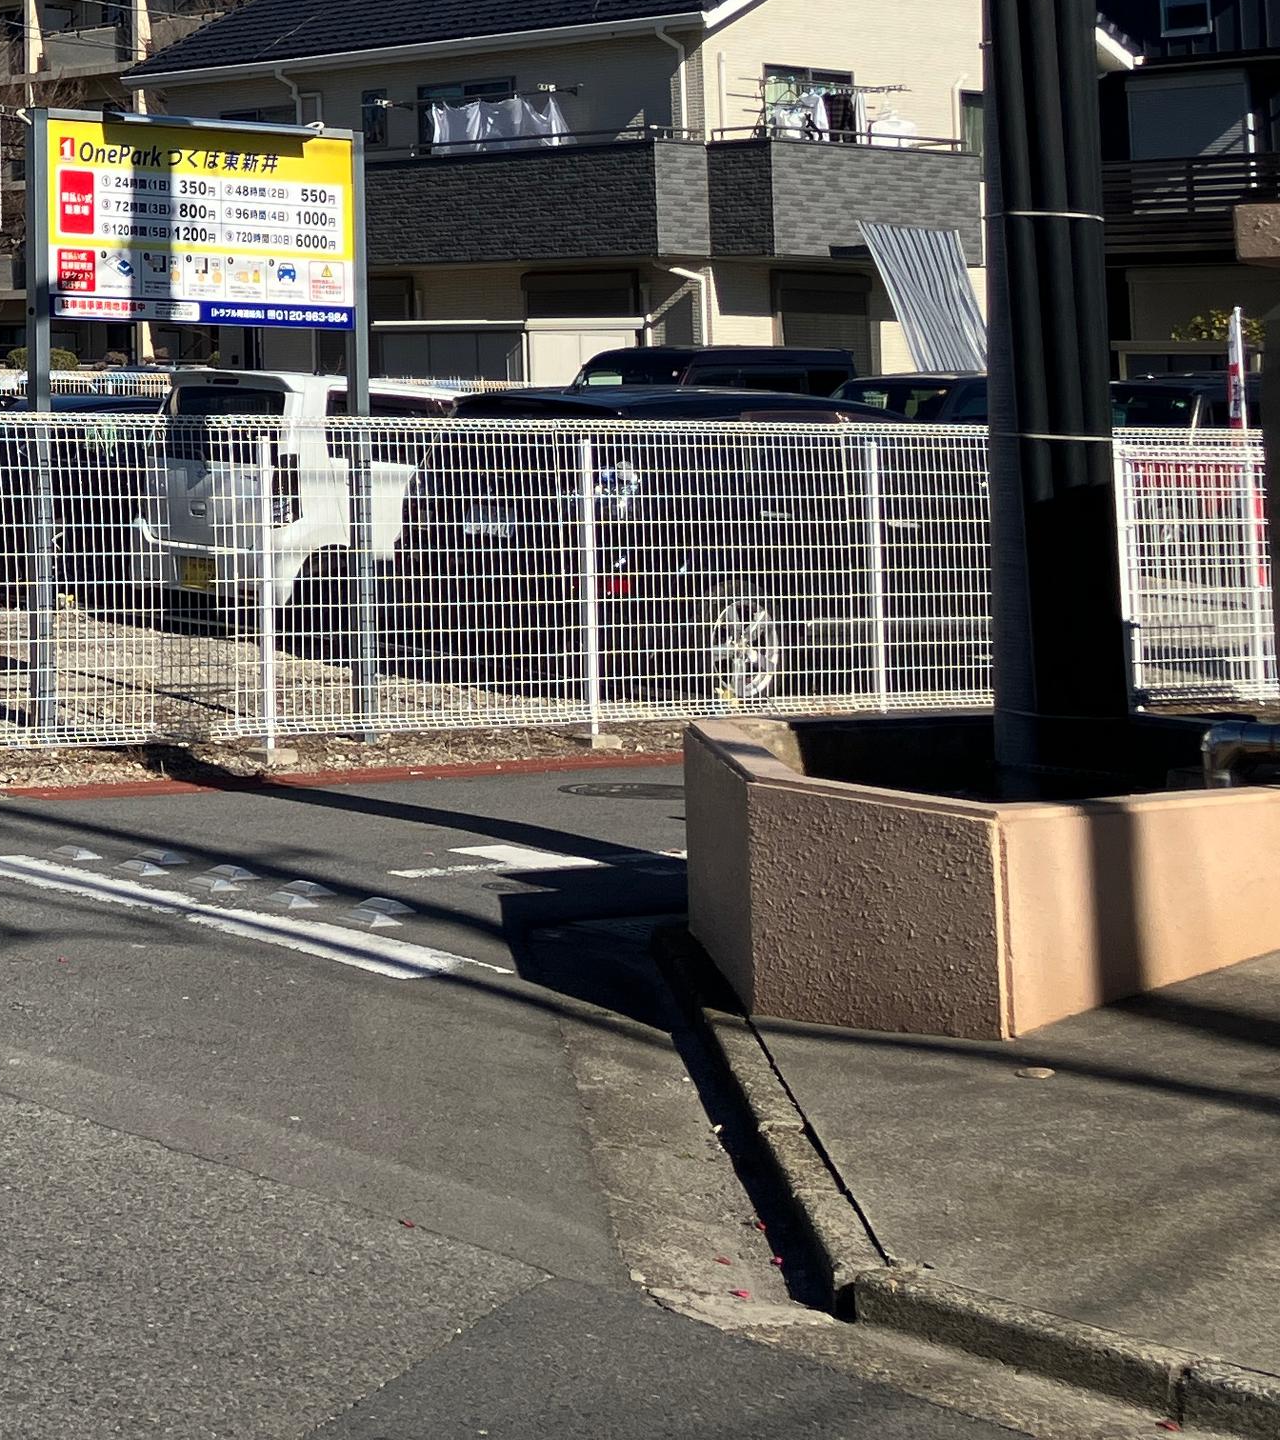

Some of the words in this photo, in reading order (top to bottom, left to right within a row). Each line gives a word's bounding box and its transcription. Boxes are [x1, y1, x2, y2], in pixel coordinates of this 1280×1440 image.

[80, 142, 162, 167] OnePark
[179, 179, 216, 197] 350円
[301, 188, 336, 205] 550円
[179, 203, 216, 220] 800円
[296, 211, 336, 227] 1000円
[175, 226, 216, 244] 1200円
[296, 234, 336, 250] 6000円
